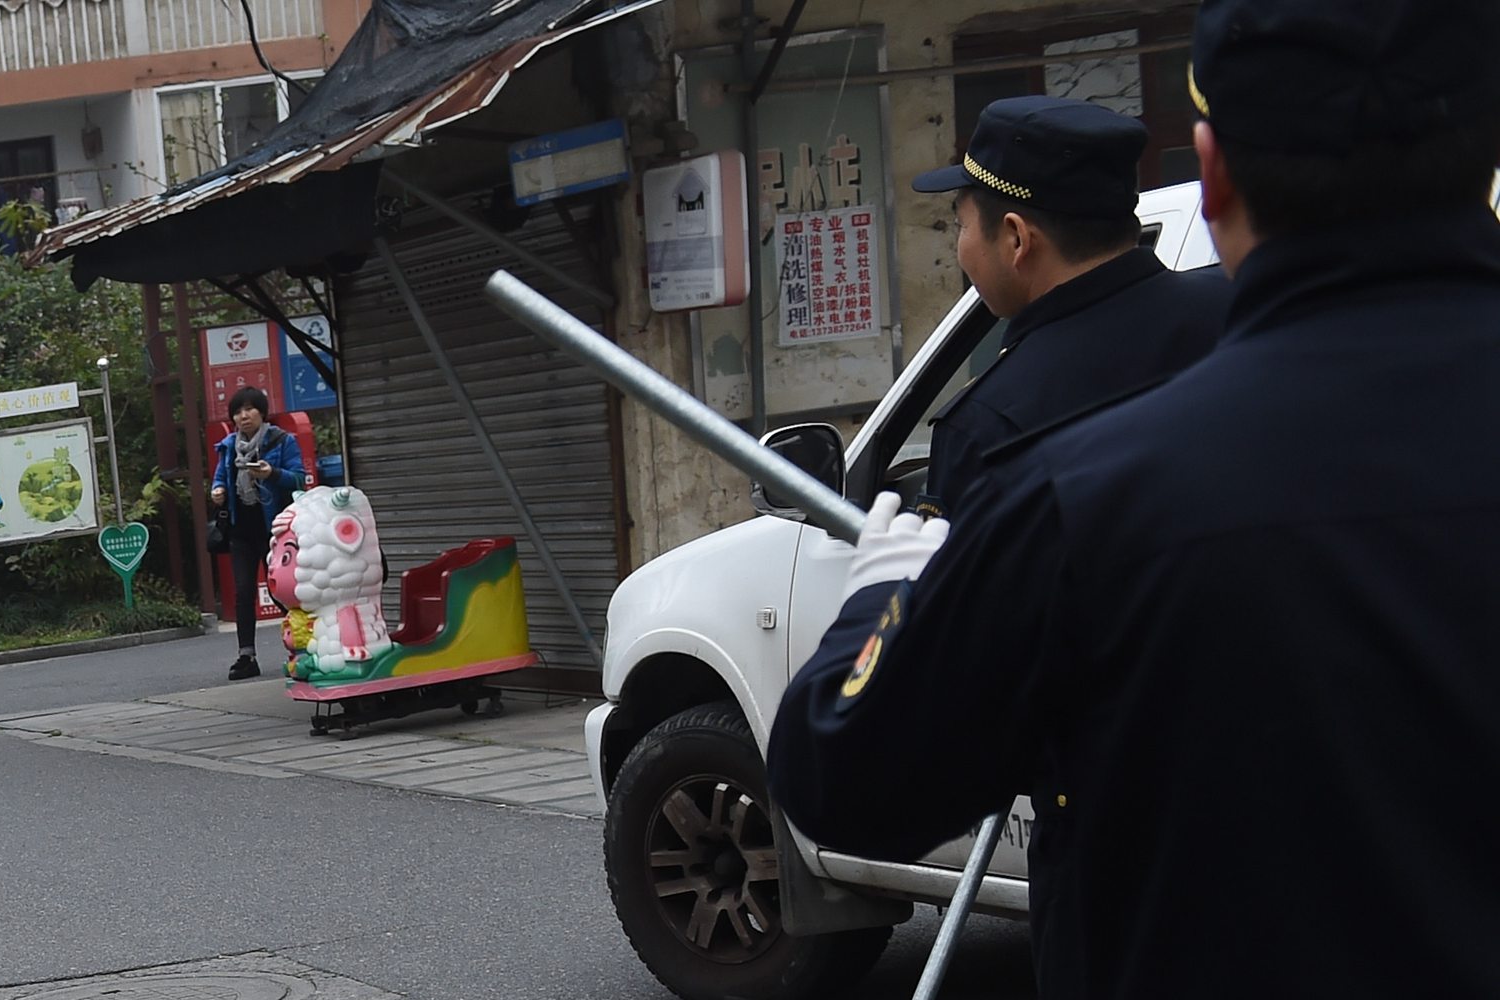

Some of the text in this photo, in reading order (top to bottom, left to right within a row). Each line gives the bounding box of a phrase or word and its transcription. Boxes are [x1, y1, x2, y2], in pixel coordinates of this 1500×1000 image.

[808, 215, 843, 232] 专业
[810, 228, 869, 246] 油烟机
[782, 234, 808, 326] 清洗修理
[813, 309, 872, 326] 水电维修
